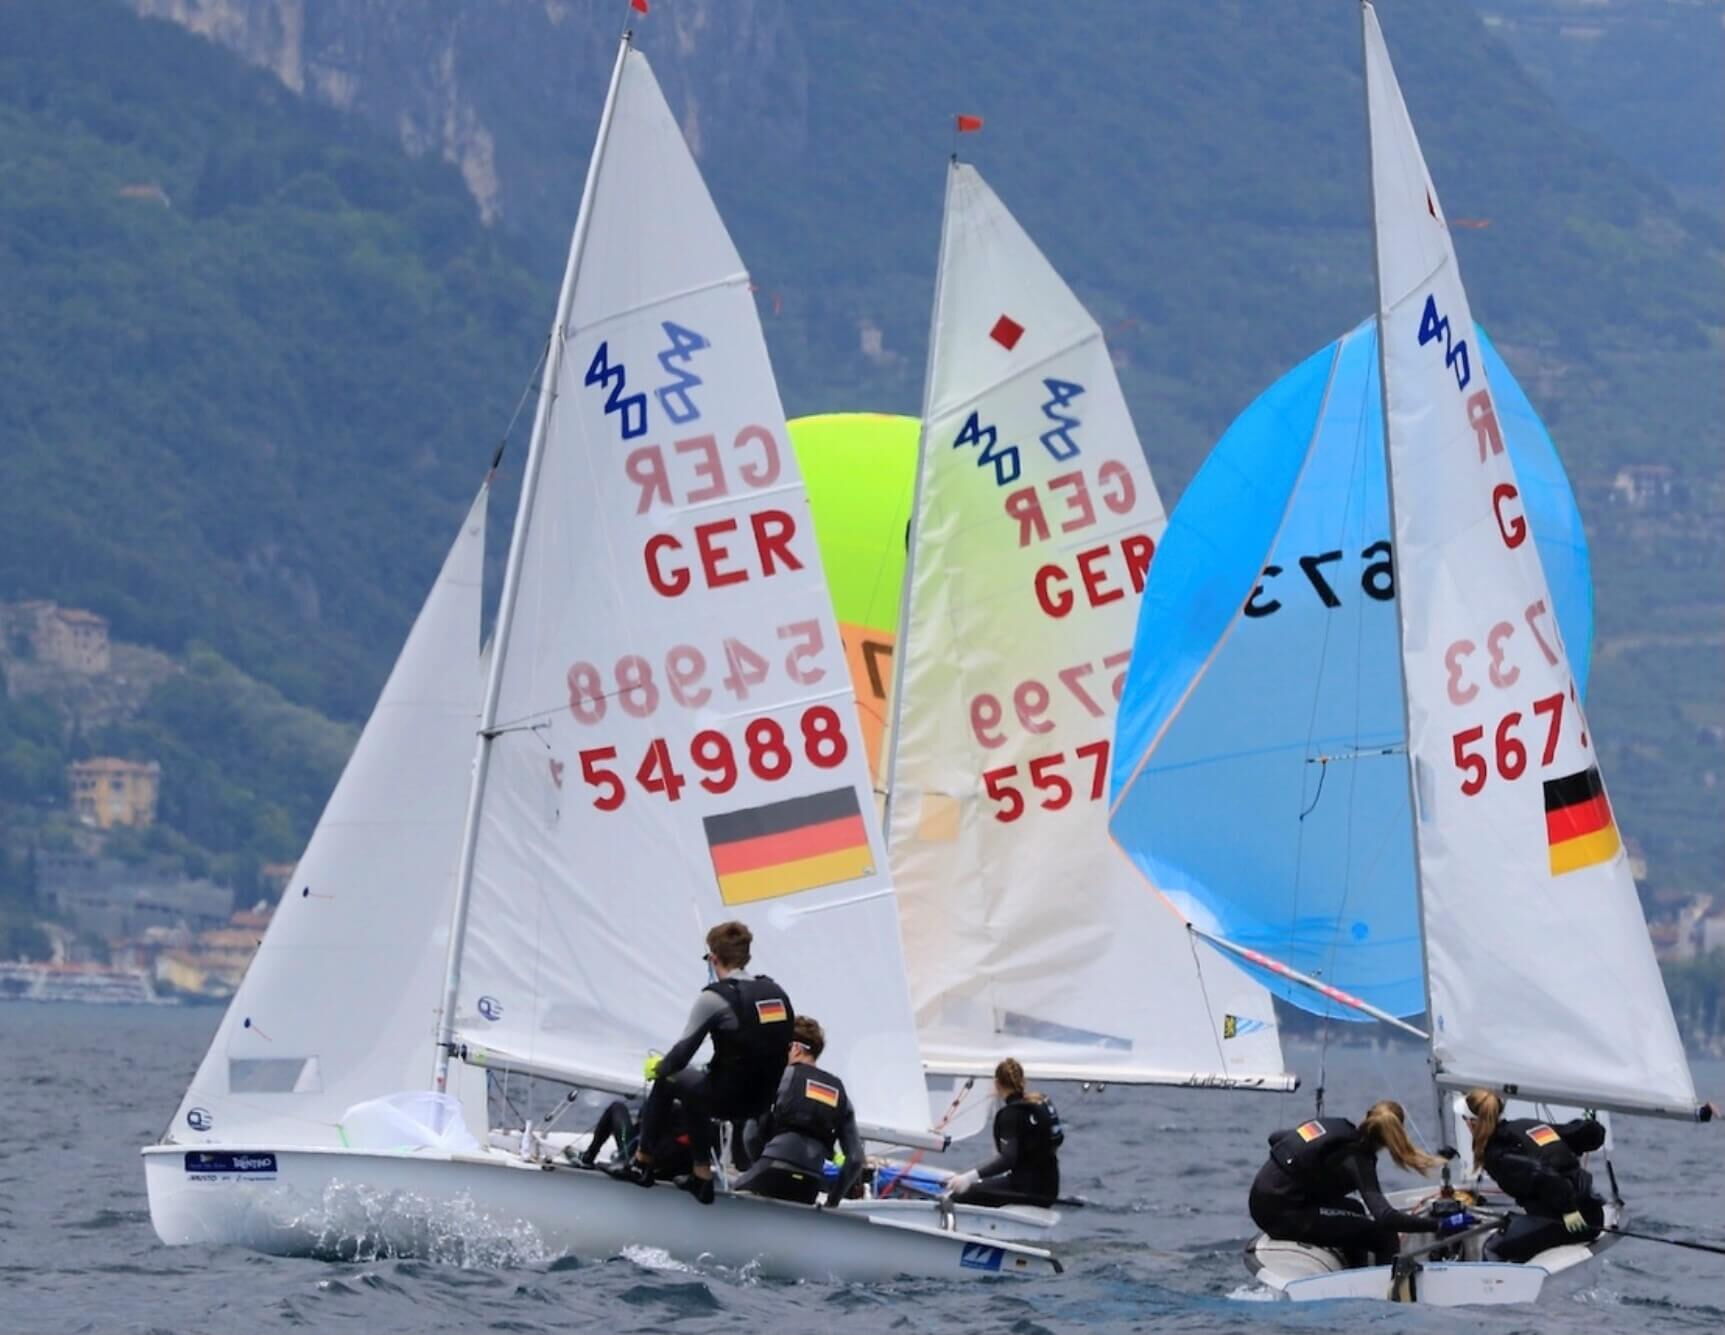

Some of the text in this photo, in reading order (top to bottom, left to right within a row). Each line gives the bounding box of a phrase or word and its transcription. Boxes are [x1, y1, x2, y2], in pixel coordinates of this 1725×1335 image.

[1418, 294, 1470, 391] 420
[585, 341, 647, 440] 420
[953, 411, 1021, 486] 420
[644, 510, 804, 598] GER
[1492, 483, 1526, 549] G
[1034, 534, 1155, 618] GER
[579, 706, 848, 812] 54988
[982, 740, 1110, 823] 557
[1453, 681, 1590, 796] 567
